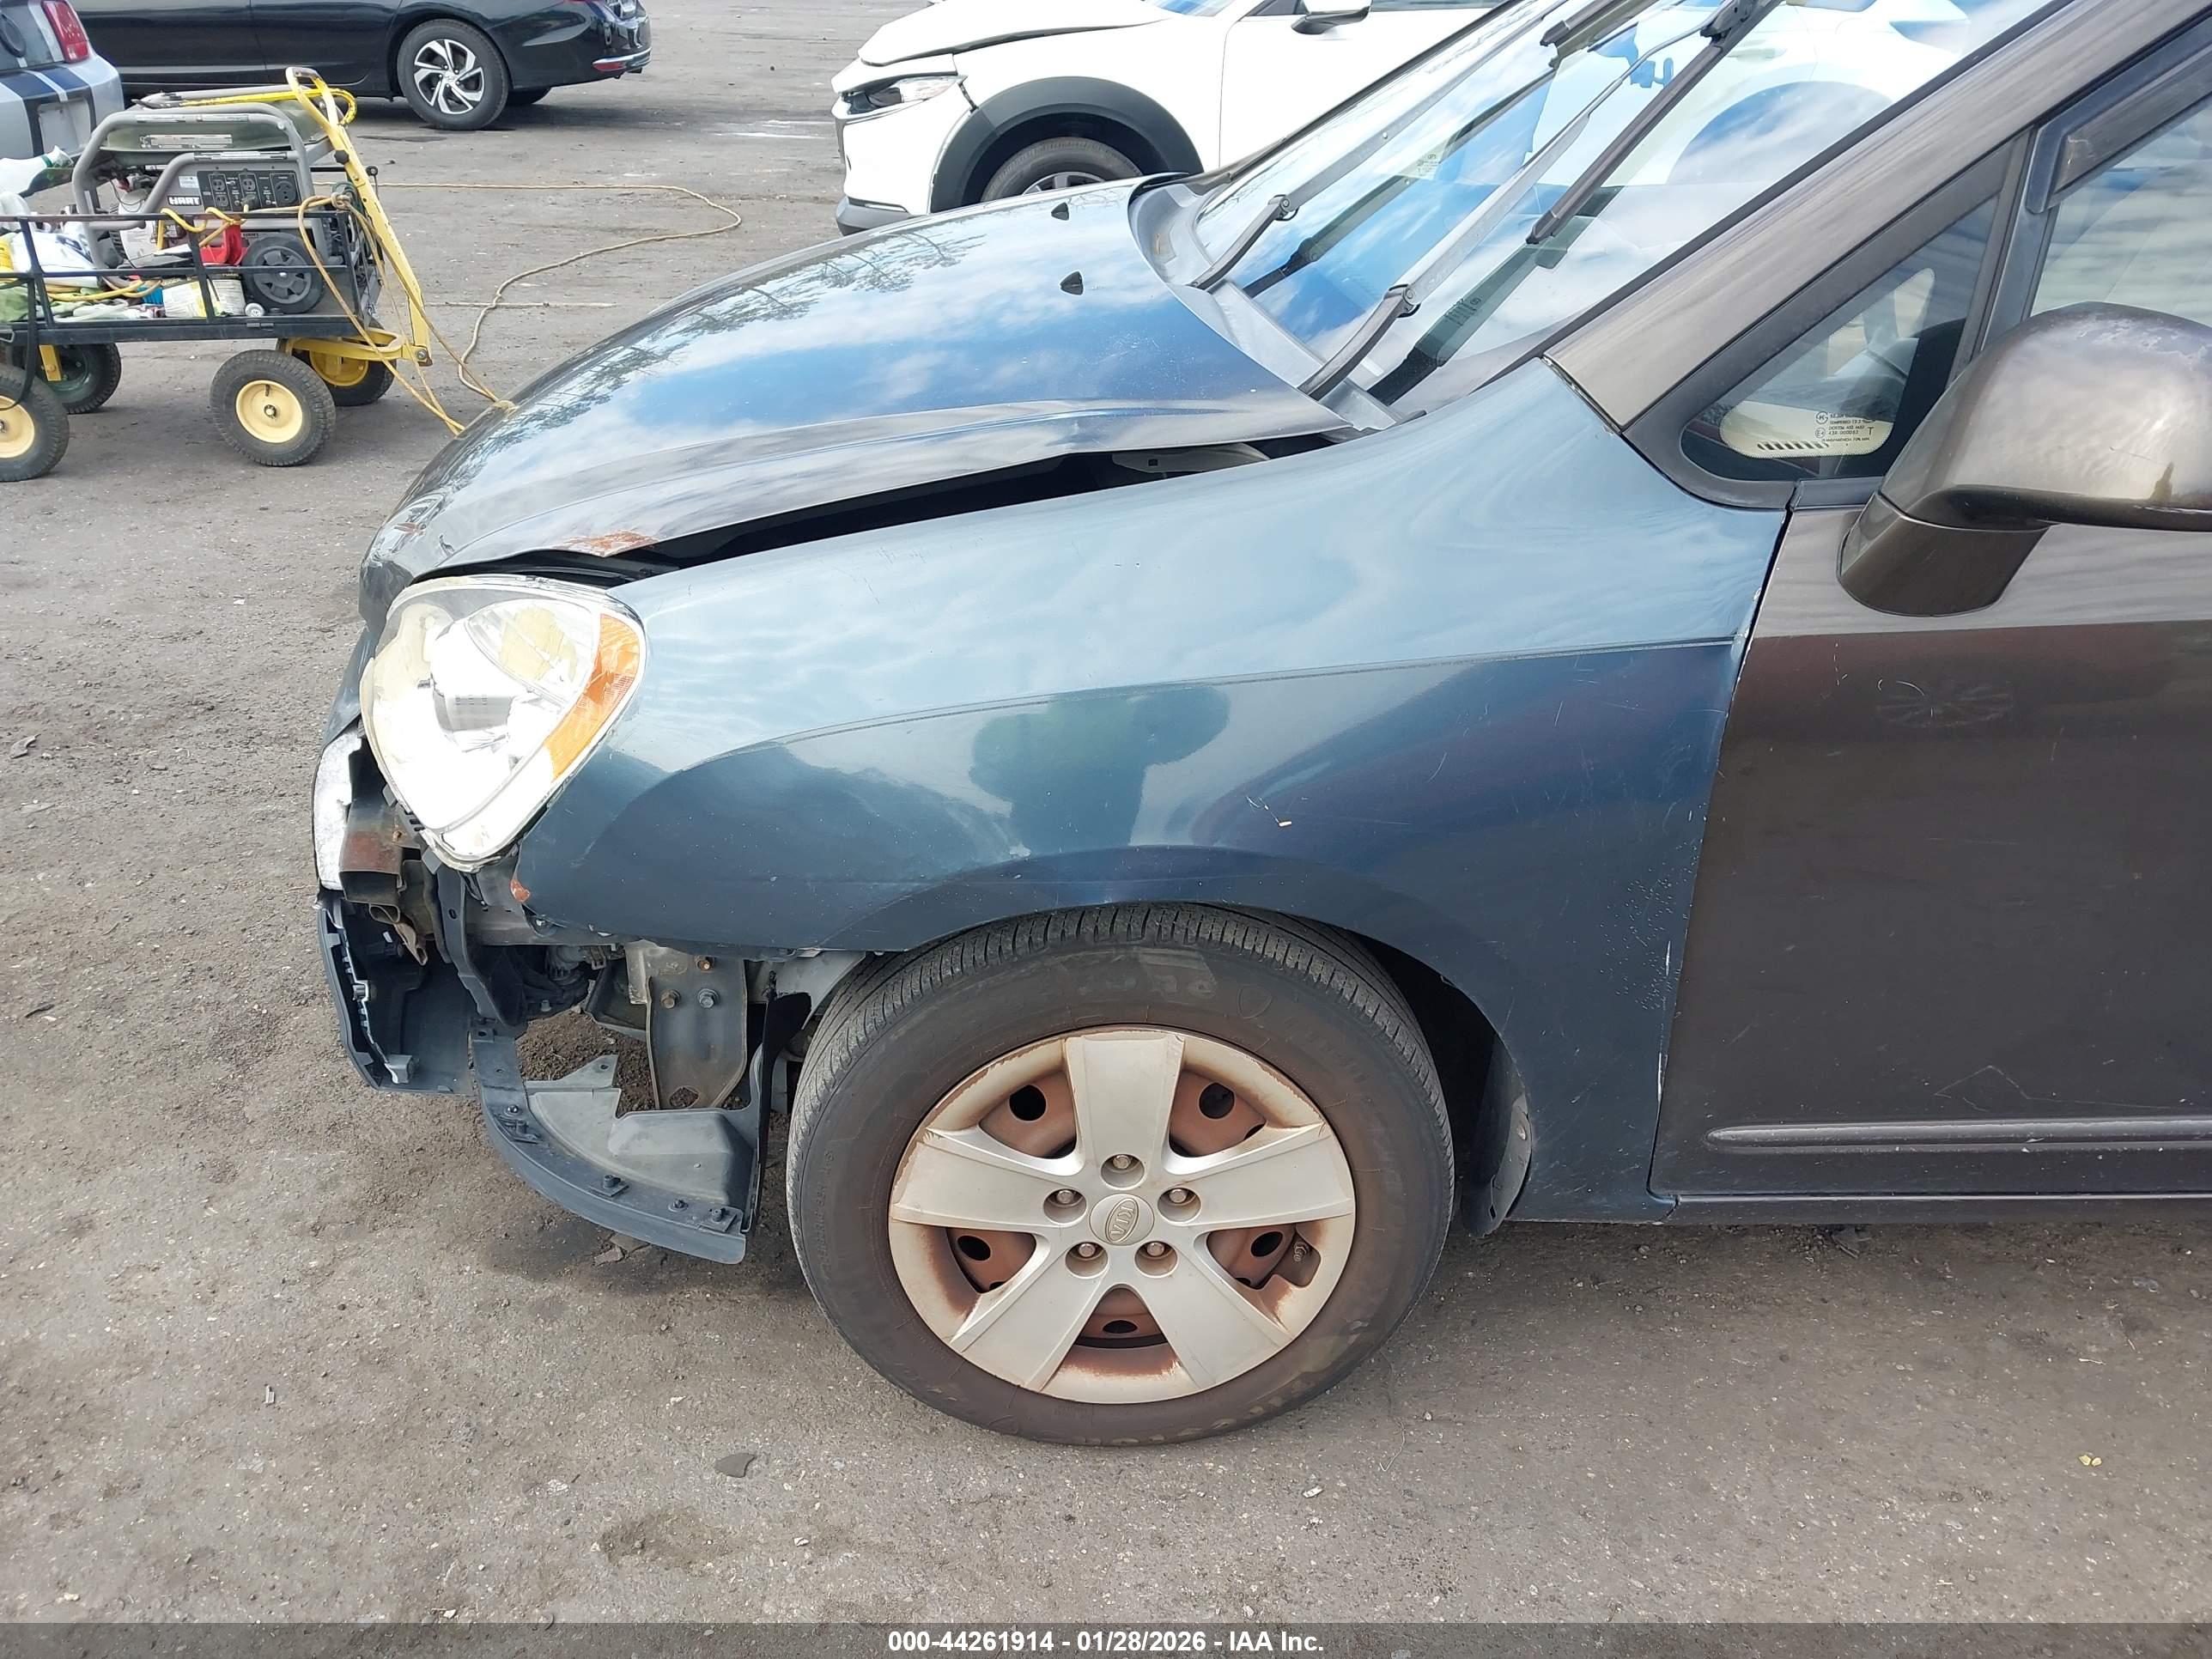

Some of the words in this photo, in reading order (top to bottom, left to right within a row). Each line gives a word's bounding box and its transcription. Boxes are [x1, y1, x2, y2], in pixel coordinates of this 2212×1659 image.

[168, 197, 200, 205] HART
[1867, 426, 1875, 435] T
[1109, 1205, 1135, 1235] KIA
